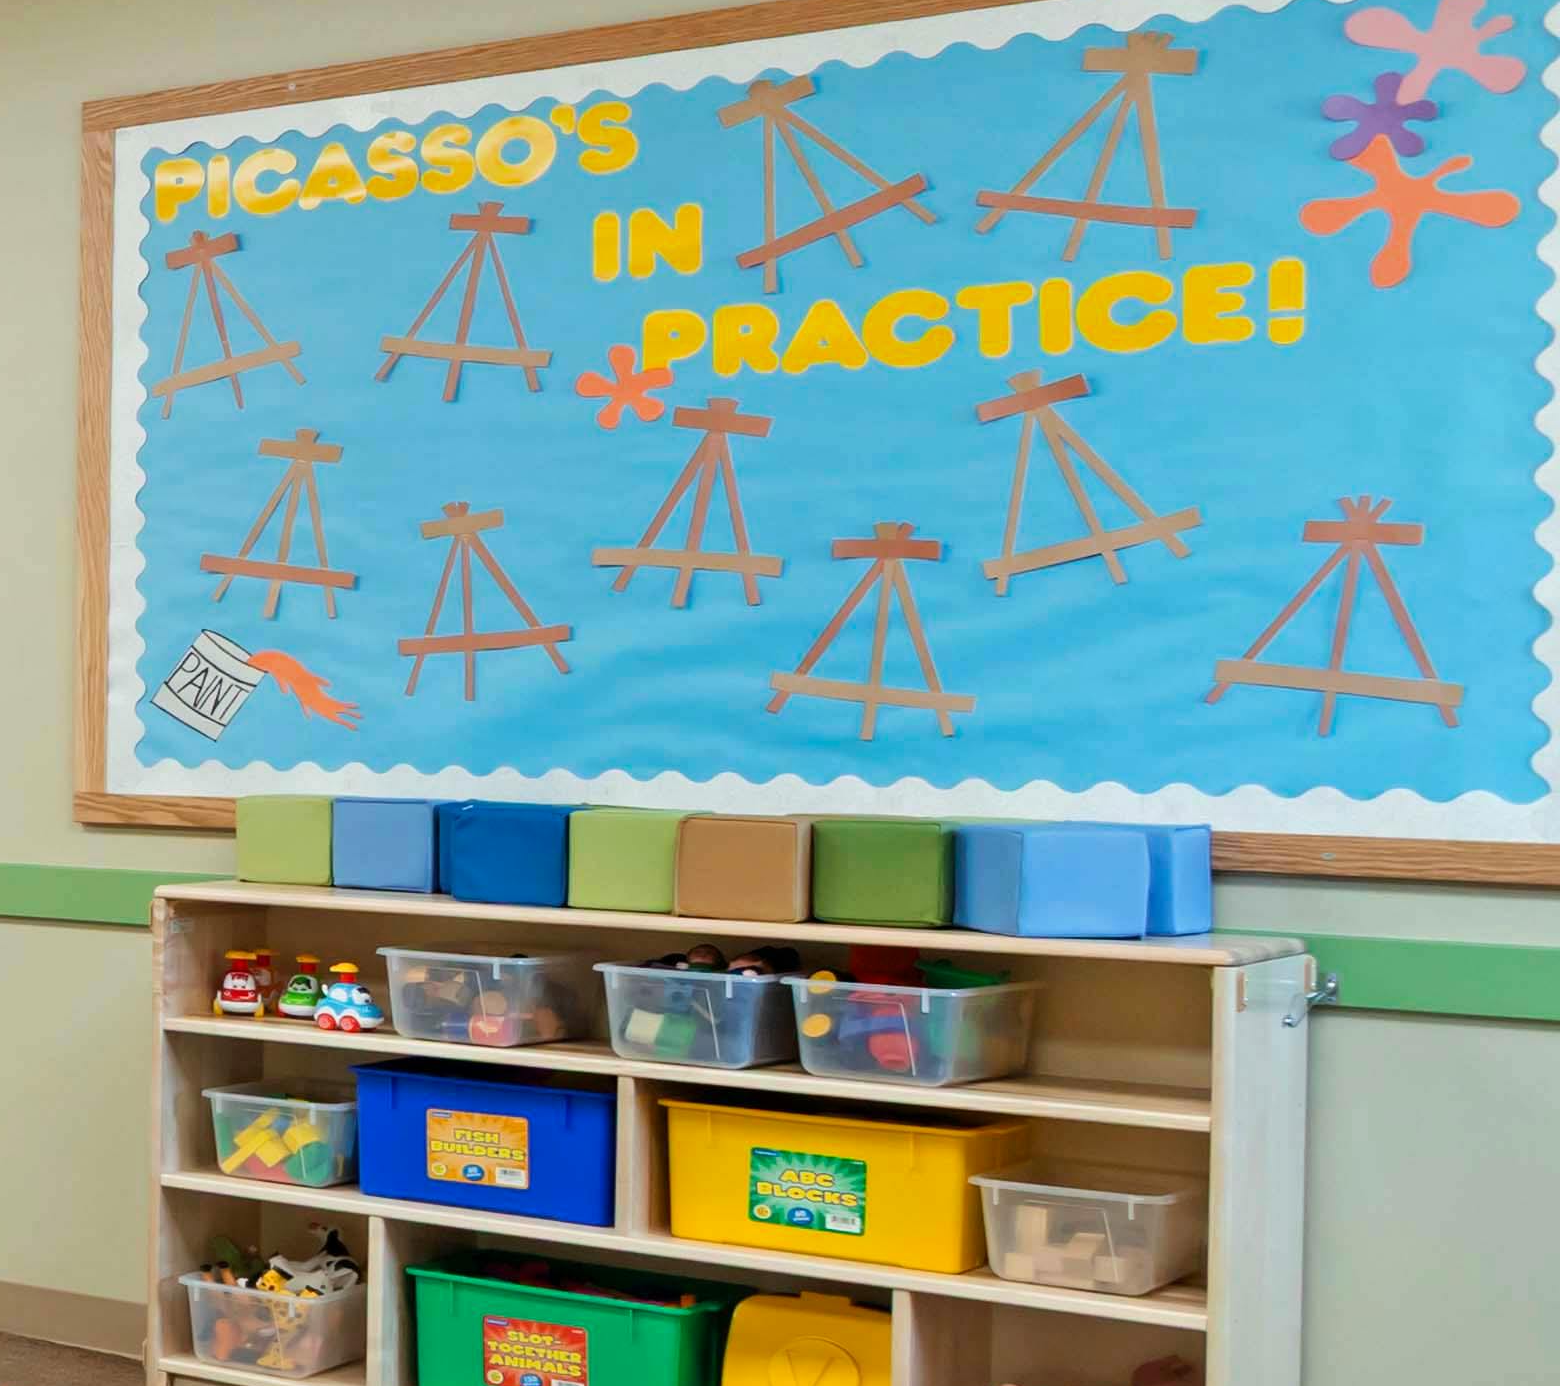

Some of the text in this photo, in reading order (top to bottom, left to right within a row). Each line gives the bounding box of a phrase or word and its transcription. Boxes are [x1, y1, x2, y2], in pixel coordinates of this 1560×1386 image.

[154, 101, 639, 222] PICASSO'S
[592, 202, 704, 282] IN
[640, 256, 1308, 377] PRACTICE!
[166, 652, 250, 720] PAINT
[454, 1129, 499, 1144] FISH
[430, 1140, 525, 1162] BUILDERS
[779, 1169, 835, 1188] ABC
[756, 1181, 858, 1208] BLOCKS
[487, 1340, 582, 1364] TOGETHER
[488, 1354, 582, 1377] ANIMALS
